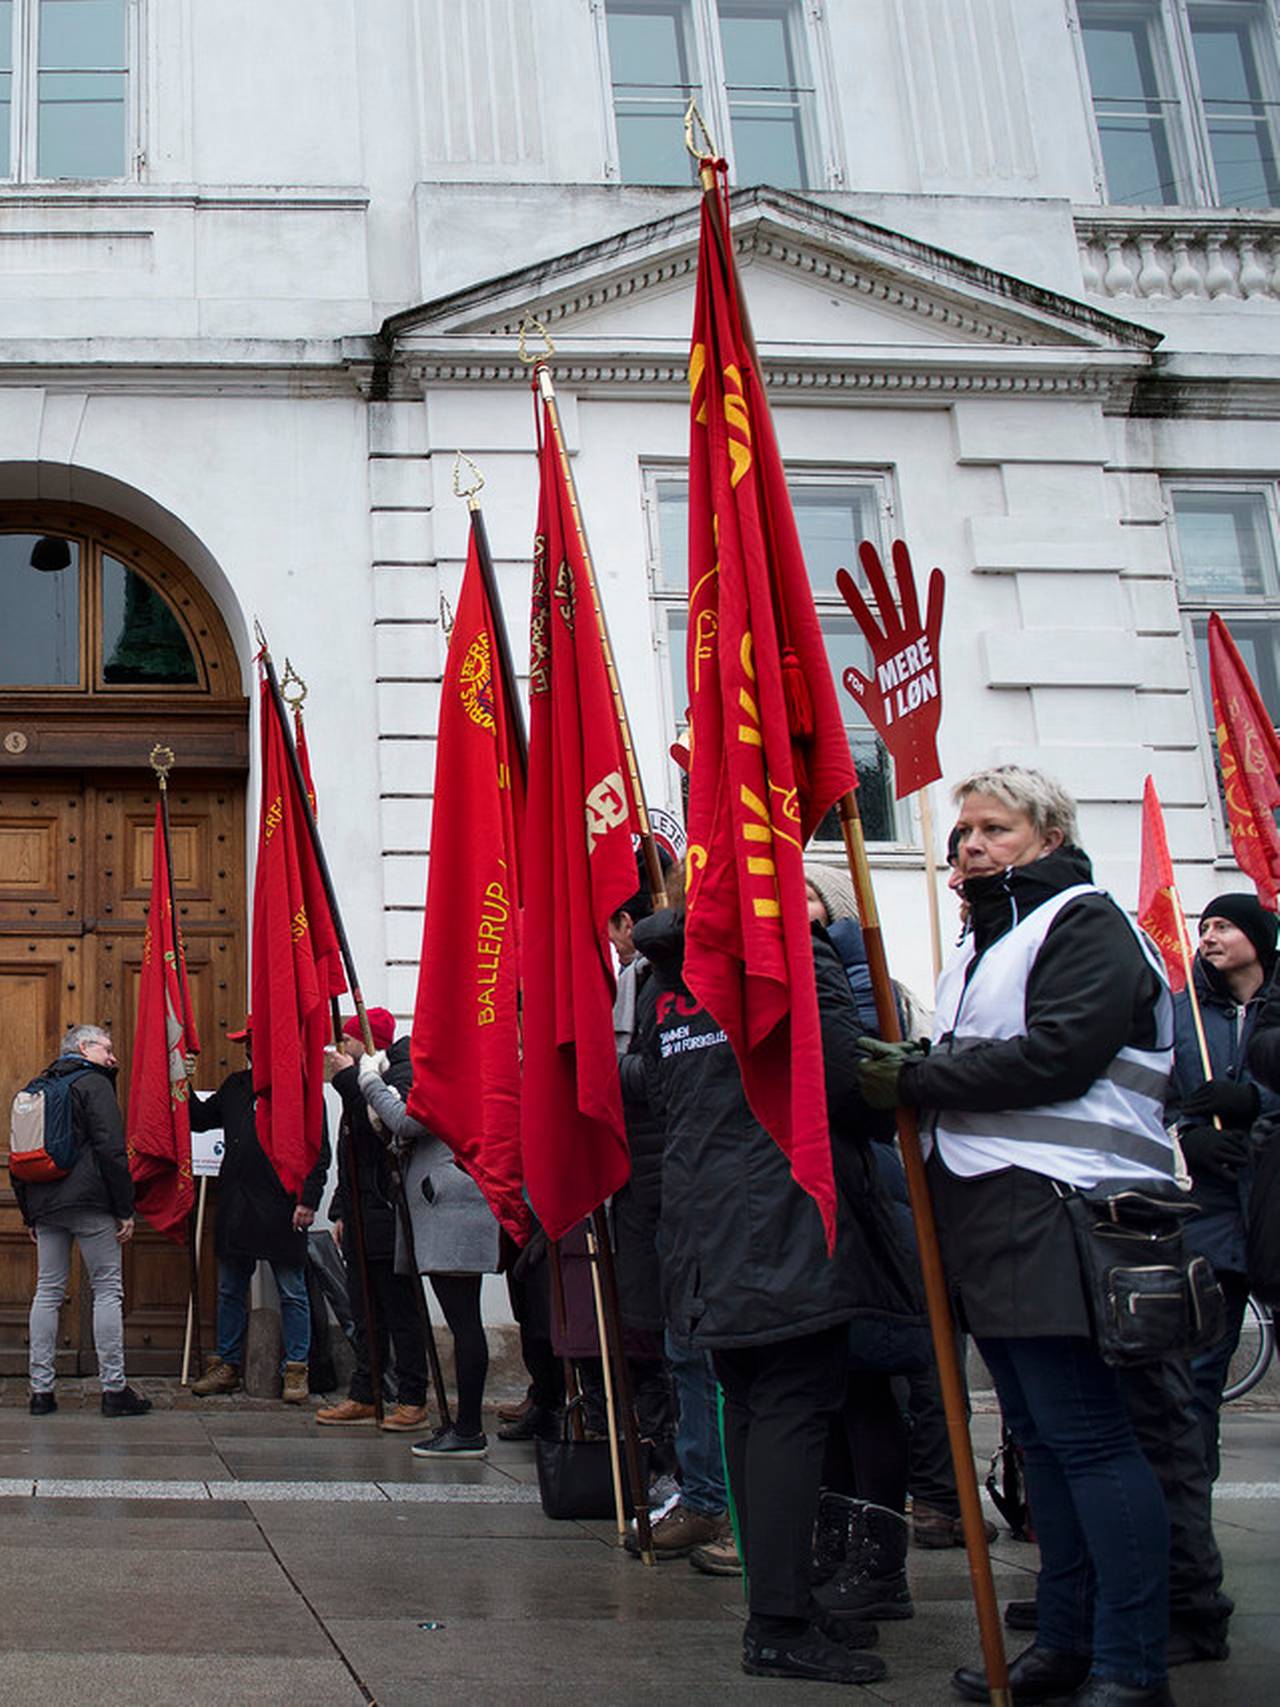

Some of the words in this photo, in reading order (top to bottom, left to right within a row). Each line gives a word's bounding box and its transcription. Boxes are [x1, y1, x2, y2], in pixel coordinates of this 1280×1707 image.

[877, 635, 933, 694] MERE
[884, 697, 893, 726] I
[897, 668, 938, 718] LØN
[476, 882, 511, 1026] BALLERUP
